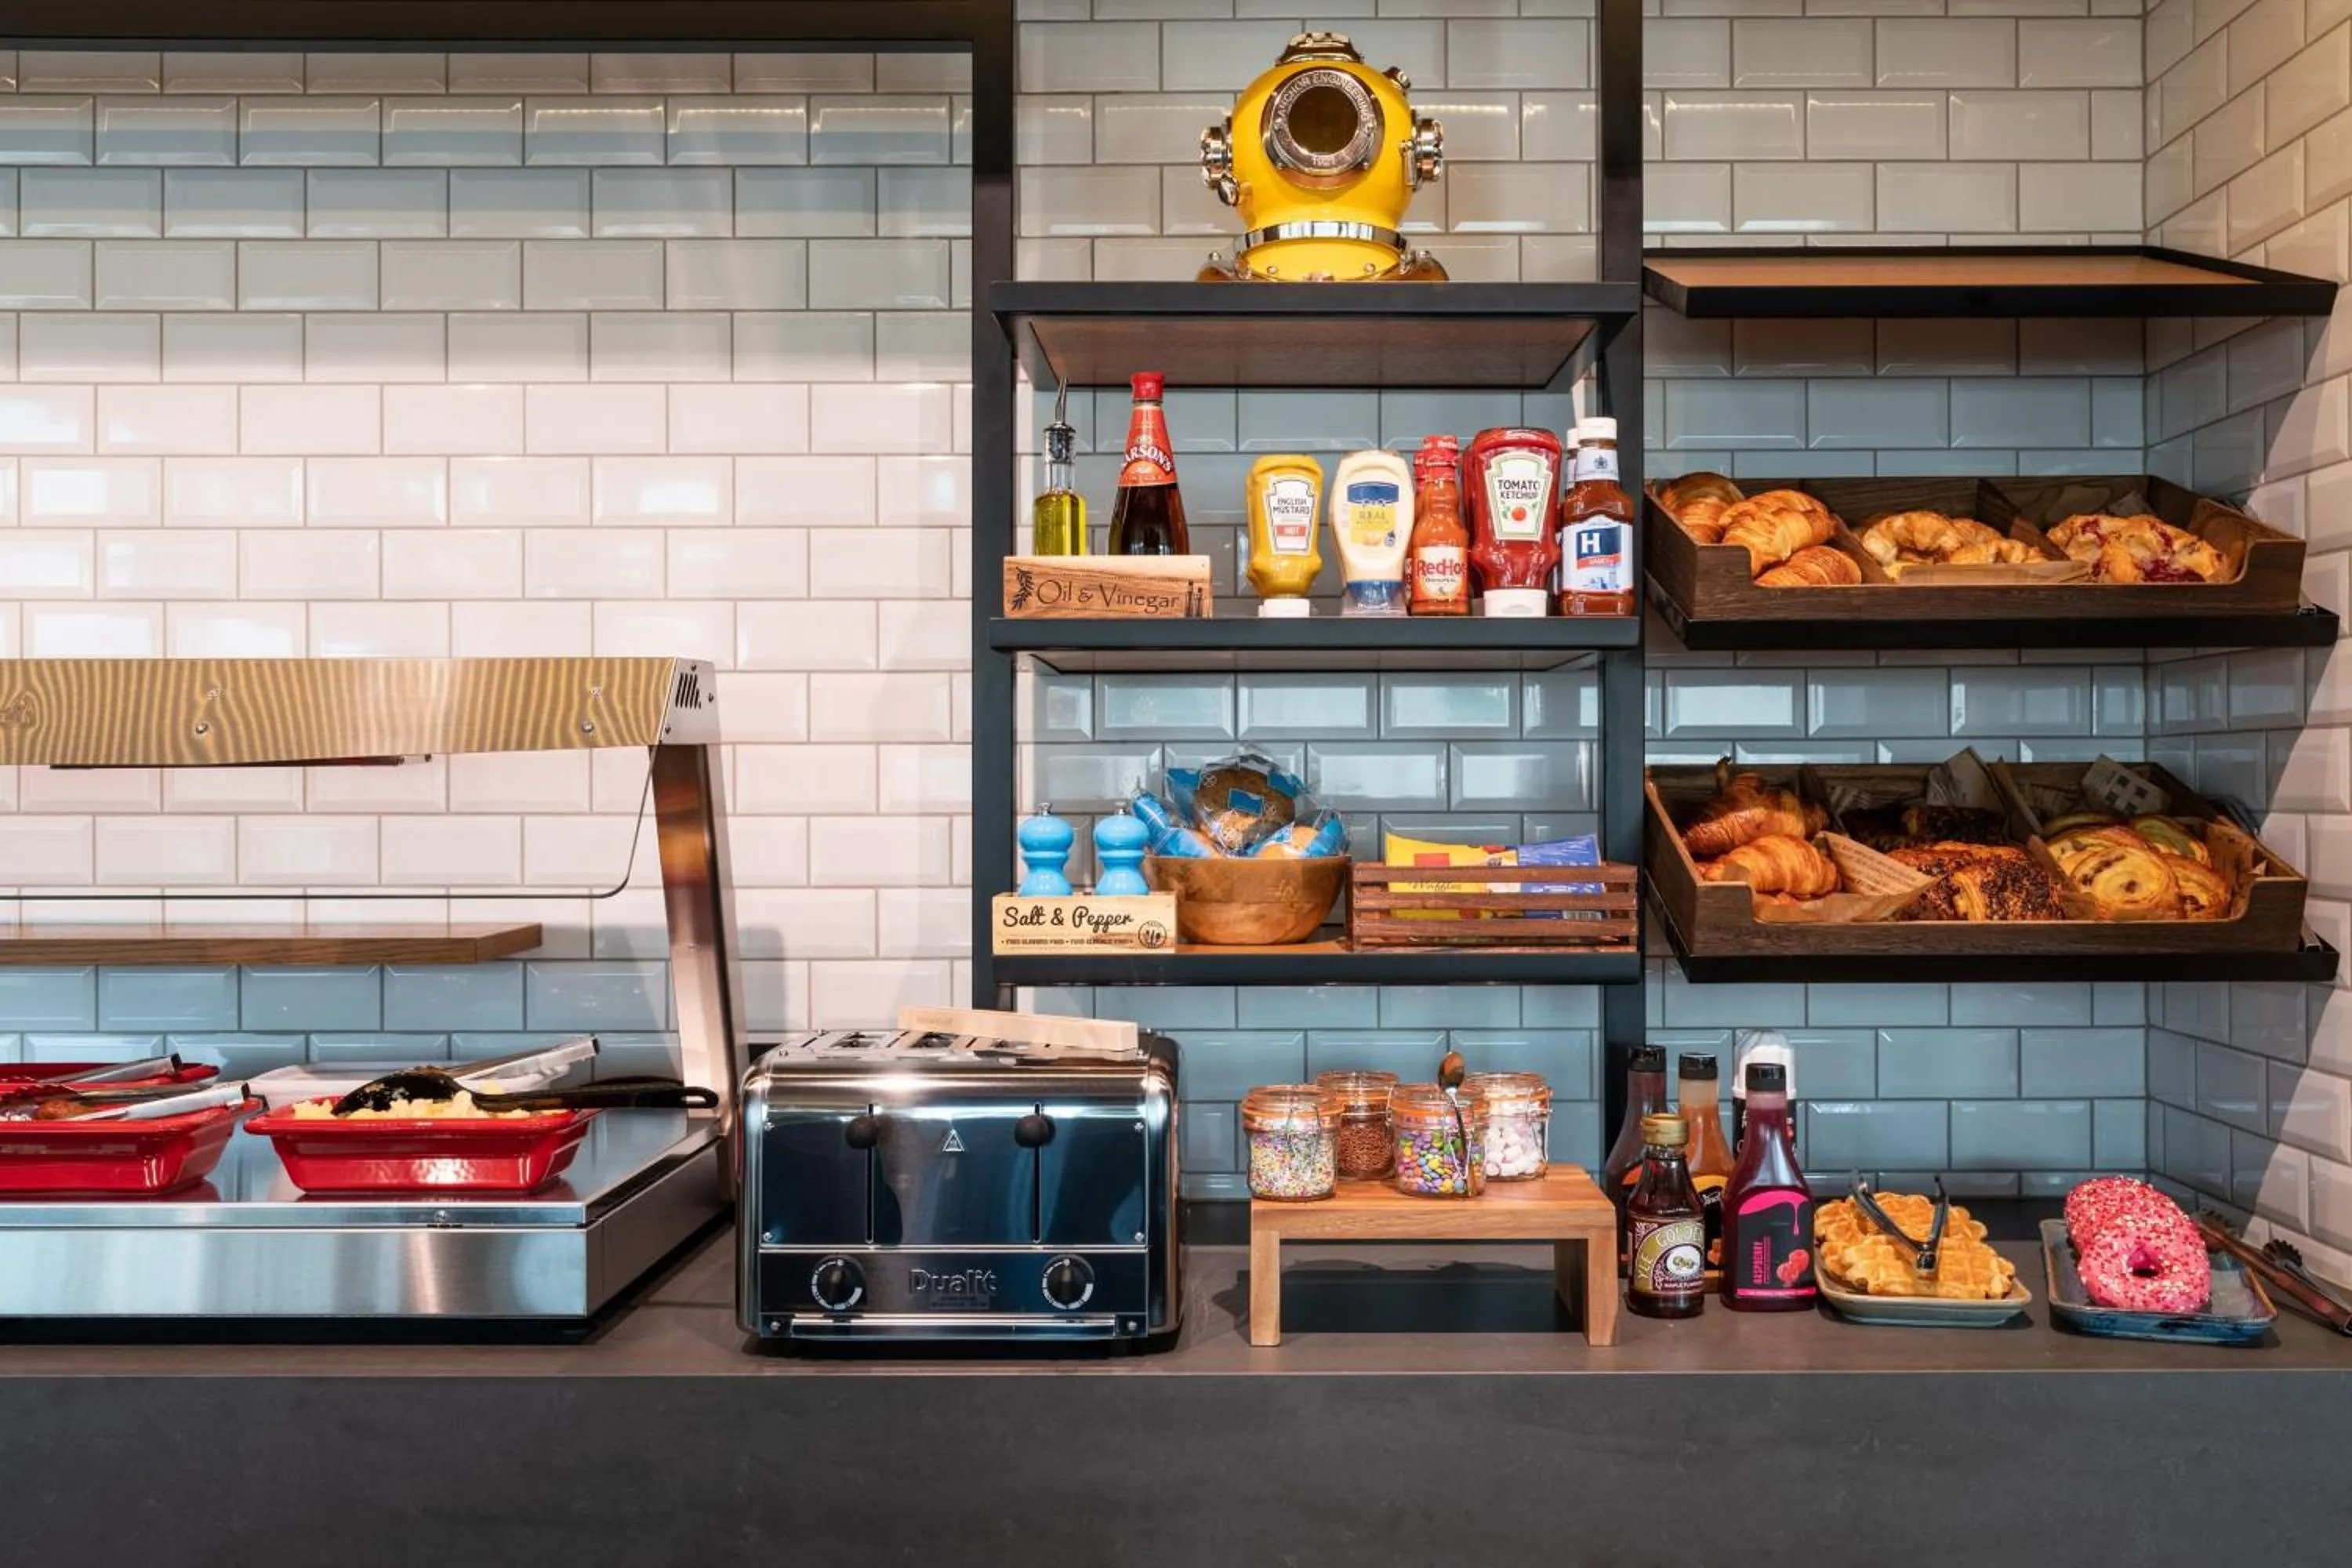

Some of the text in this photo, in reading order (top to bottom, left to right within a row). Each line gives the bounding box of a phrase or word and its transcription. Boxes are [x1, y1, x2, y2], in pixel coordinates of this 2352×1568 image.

[1277, 73, 1369, 121] ANCHOR ENGINEERING
[1497, 479, 1541, 490] TOMATO
[1277, 497, 1307, 506] ENGLISH
[1500, 490, 1539, 499] KETCHUP
[1273, 506, 1310, 514] MUSTARD
[1036, 579, 1181, 614] Oil & Vinegar
[1003, 905, 1134, 933] Salt & Pepper
[909, 1269, 997, 1295] Dualit
